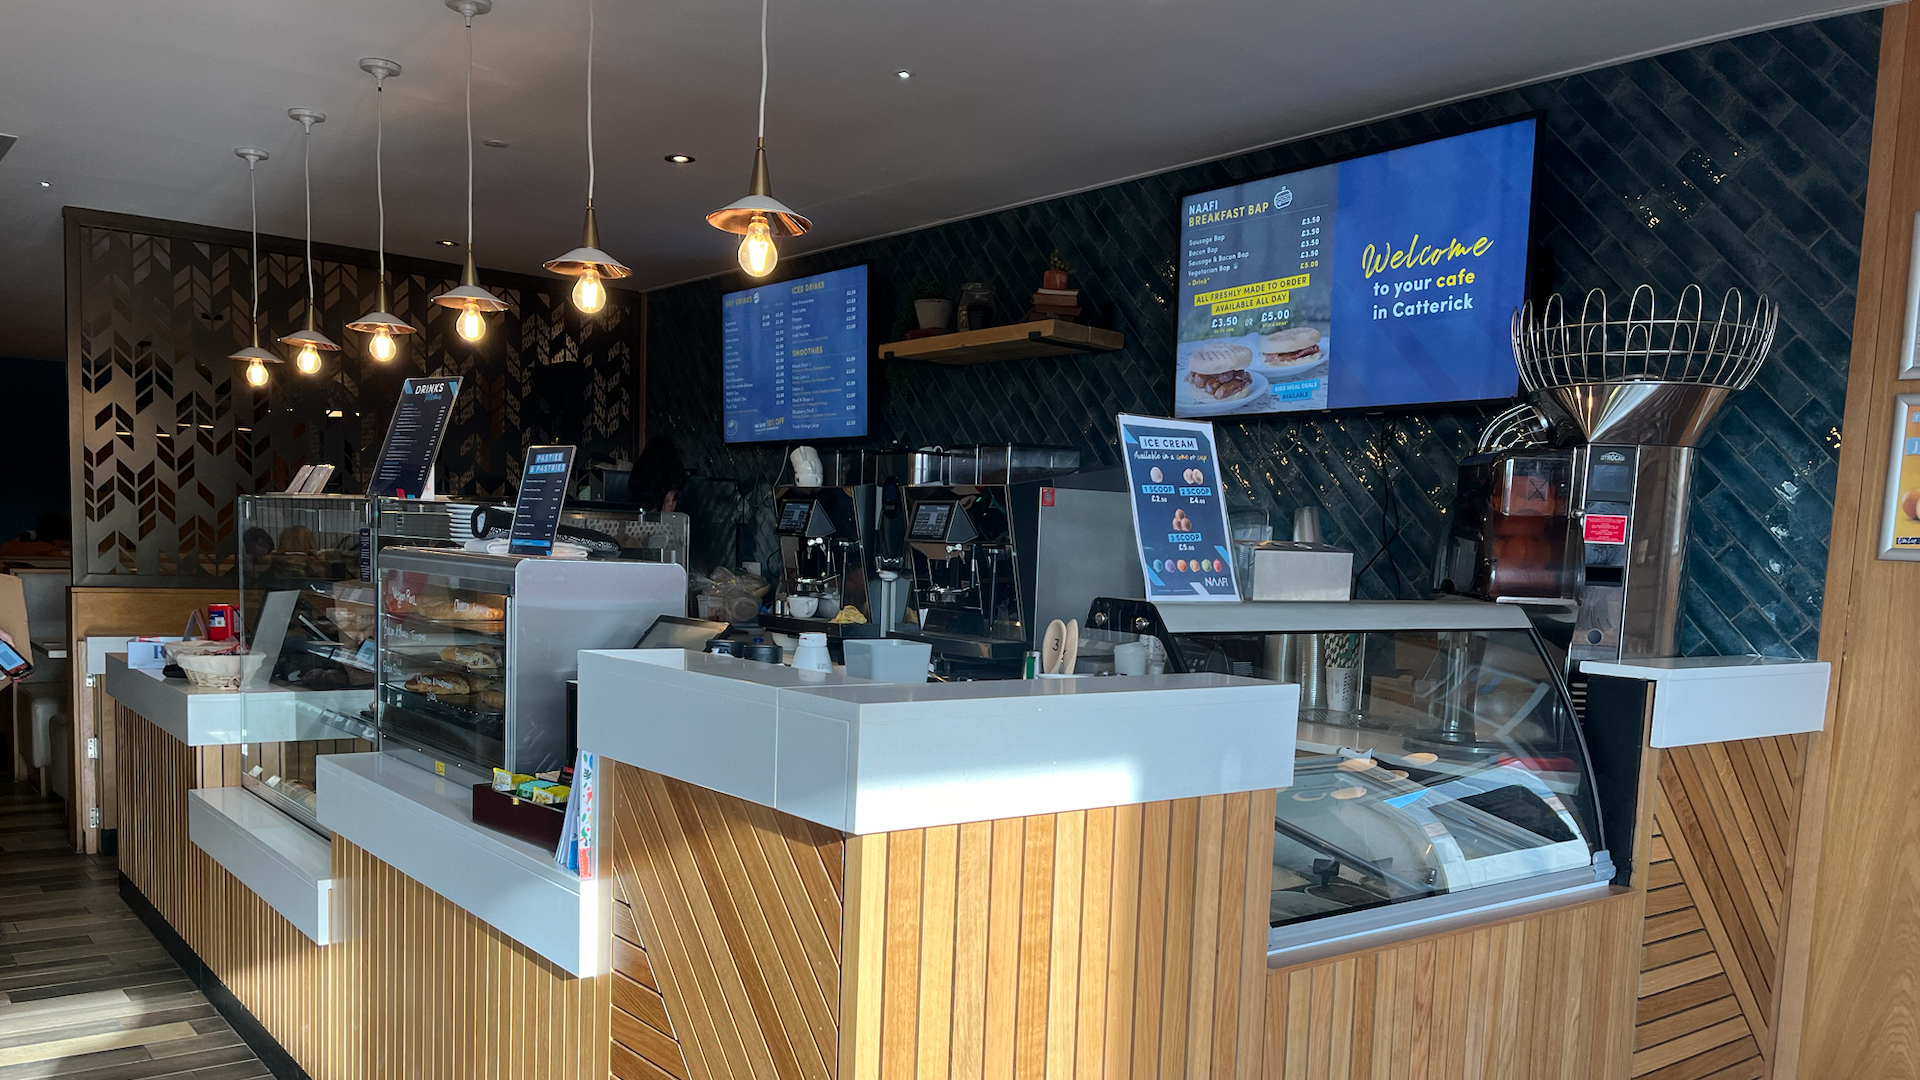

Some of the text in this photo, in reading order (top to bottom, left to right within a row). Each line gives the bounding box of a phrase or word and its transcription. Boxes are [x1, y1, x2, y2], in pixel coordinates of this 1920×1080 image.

[1188, 199, 1218, 215] NAAFI
[1188, 202, 1269, 227] BREAKFAST BAP
[1301, 216, 1321, 225] £3.50
[1301, 227, 1320, 237] £3.50
[1189, 234, 1226, 247] Sausage Bap
[1300, 238, 1320, 248] £3.50
[1188, 247, 1219, 257] Bacon Bap
[1300, 250, 1319, 259] £3.50
[1362, 233, 1494, 279] Welcome
[1188, 258, 1212, 267] Sausage
[1218, 253, 1236, 262] Bacon
[1237, 251, 1250, 260] Bap
[1300, 260, 1319, 270] £5.00
[1188, 264, 1231, 278] Vegetarian Bap
[791, 281, 825, 295] ICED DRINKS
[1373, 268, 1475, 298] to your cafe
[1196, 276, 1307, 304] ALL FRESHLY MADE TO ORDER
[1215, 293, 1287, 313] AVAILABLE ALL DAY
[1373, 292, 1474, 320] in Catterick
[1211, 316, 1238, 328] £3.50
[1261, 309, 1290, 322] £5.00
[792, 346, 823, 357] SMOOTHIES
[415, 383, 445, 395] DRINKS
[1275, 381, 1317, 392] KIDS MEAL DEALS
[1282, 391, 1309, 400] AVAILABLE
[1143, 438, 1195, 448] ICE CREAM
[537, 453, 563, 462] PASTIES
[1134, 451, 1162, 460] Available
[536, 464, 565, 472] PASTRIES
[1052, 638, 1060, 651] 3
